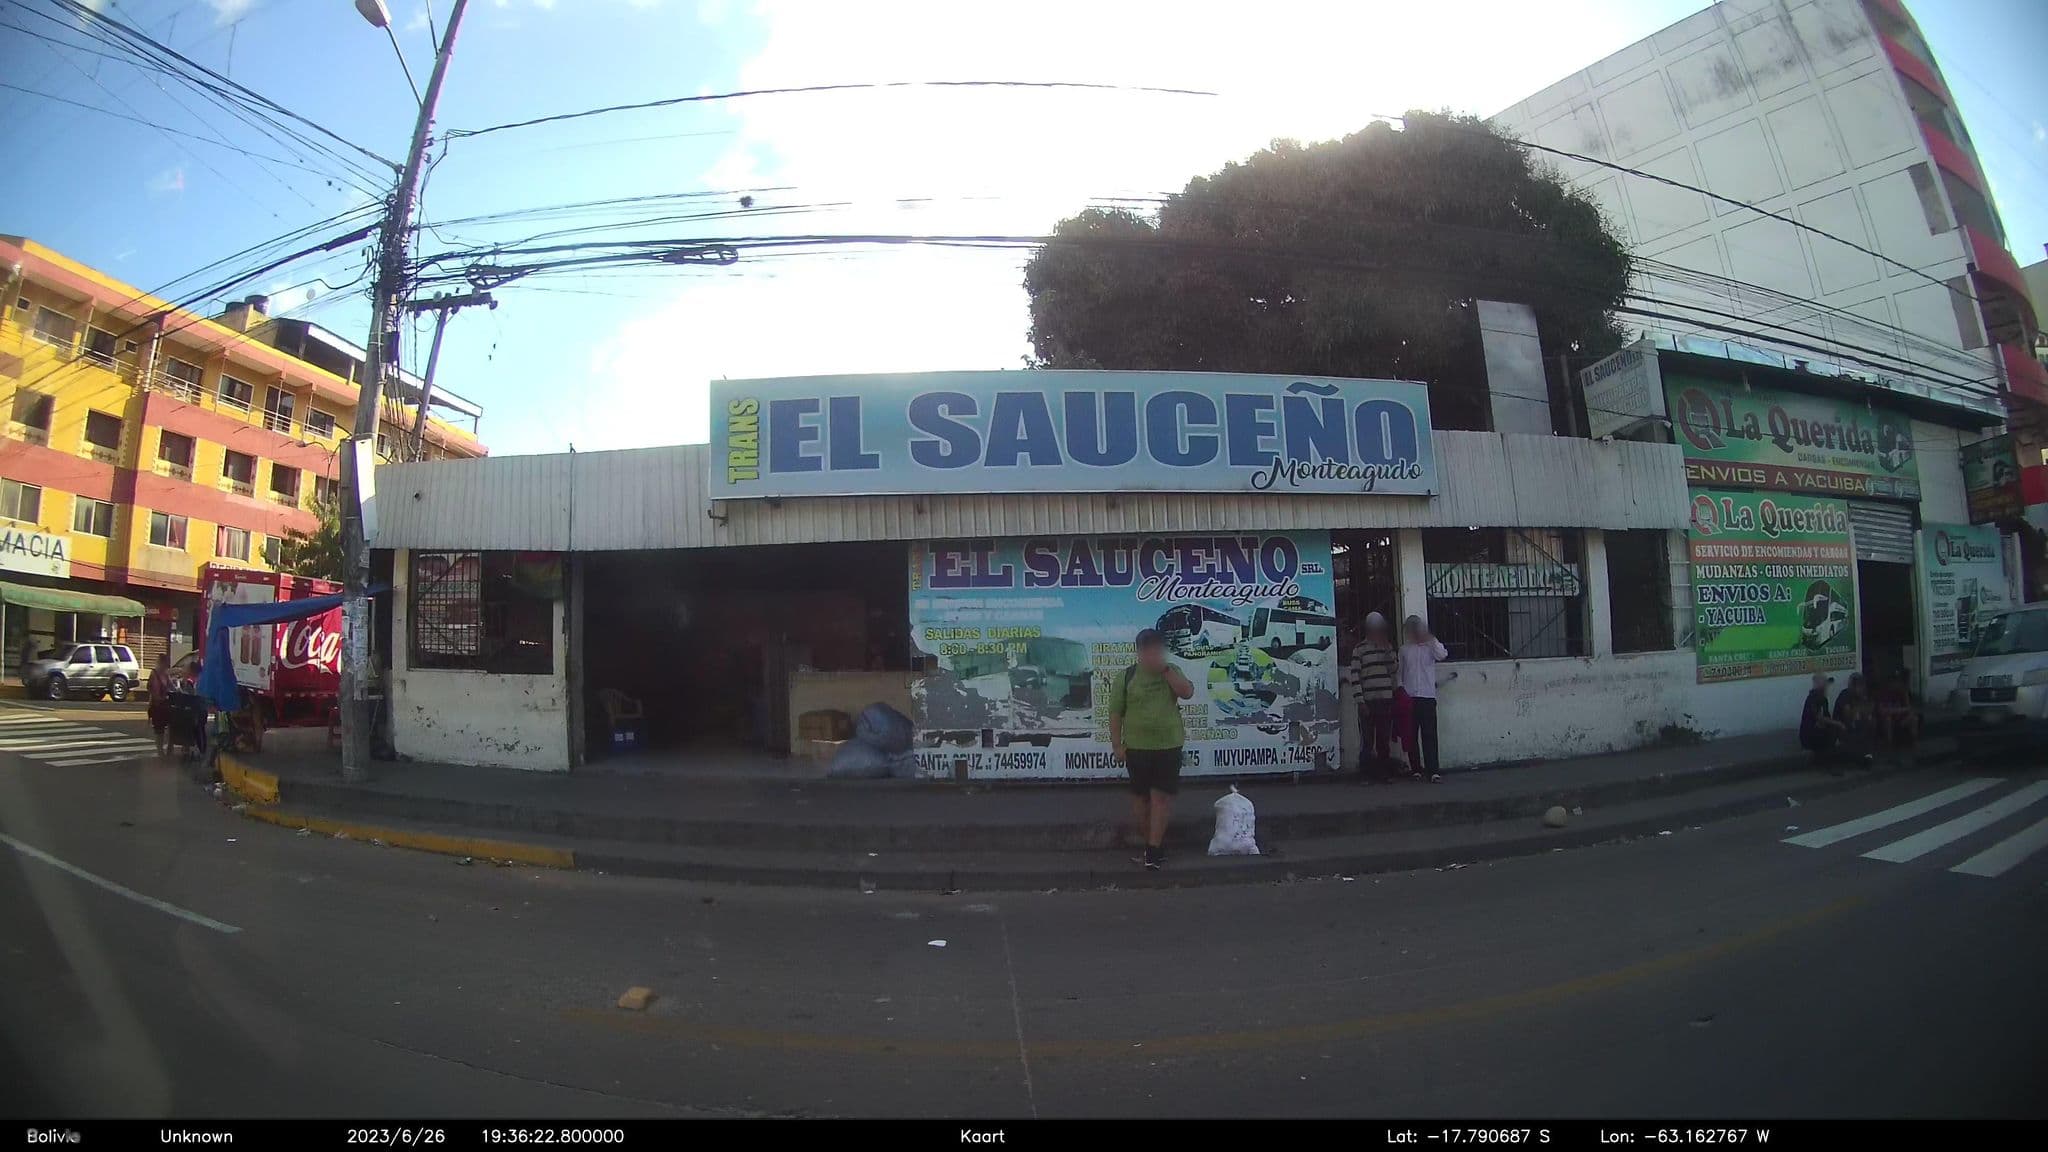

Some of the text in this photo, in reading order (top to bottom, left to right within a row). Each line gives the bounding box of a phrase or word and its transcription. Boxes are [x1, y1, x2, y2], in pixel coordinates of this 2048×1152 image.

[769, 381, 1418, 474] EL SAUCEÑO
[1720, 398, 1763, 441] La
[1768, 404, 1875, 454] Querida
[727, 396, 760, 485] TRANS
[1251, 456, 1424, 492] Monteagudo
[1685, 465, 1767, 484] ENVIOS
[1775, 471, 1789, 486] A
[1794, 472, 1866, 492] YACUIBA
[1721, 497, 1755, 531] La
[1759, 499, 1849, 539] Querida
[928, 538, 1014, 589] EL
[1695, 545, 1740, 558] SERVICIO
[1741, 546, 1754, 557] DE
[1755, 546, 1812, 559] ENCOMIENDAS
[1813, 548, 1819, 558] Y
[1696, 564, 1758, 579] MUDANZAS
[1765, 565, 1794, 578] GIROS
[1795, 564, 1849, 578] INMEDIATOS
[1137, 576, 1299, 604] Monteagudo
[1697, 583, 1792, 604] ENVIOS A:
[1706, 606, 1767, 627] YACUIBA
[925, 627, 981, 641] SALIDAS
[988, 626, 1041, 640] DIARIAS
[914, 751, 949, 771] SANTA
[994, 751, 1047, 771] 74459974
[1214, 747, 1279, 767] MUYUPAMPA
